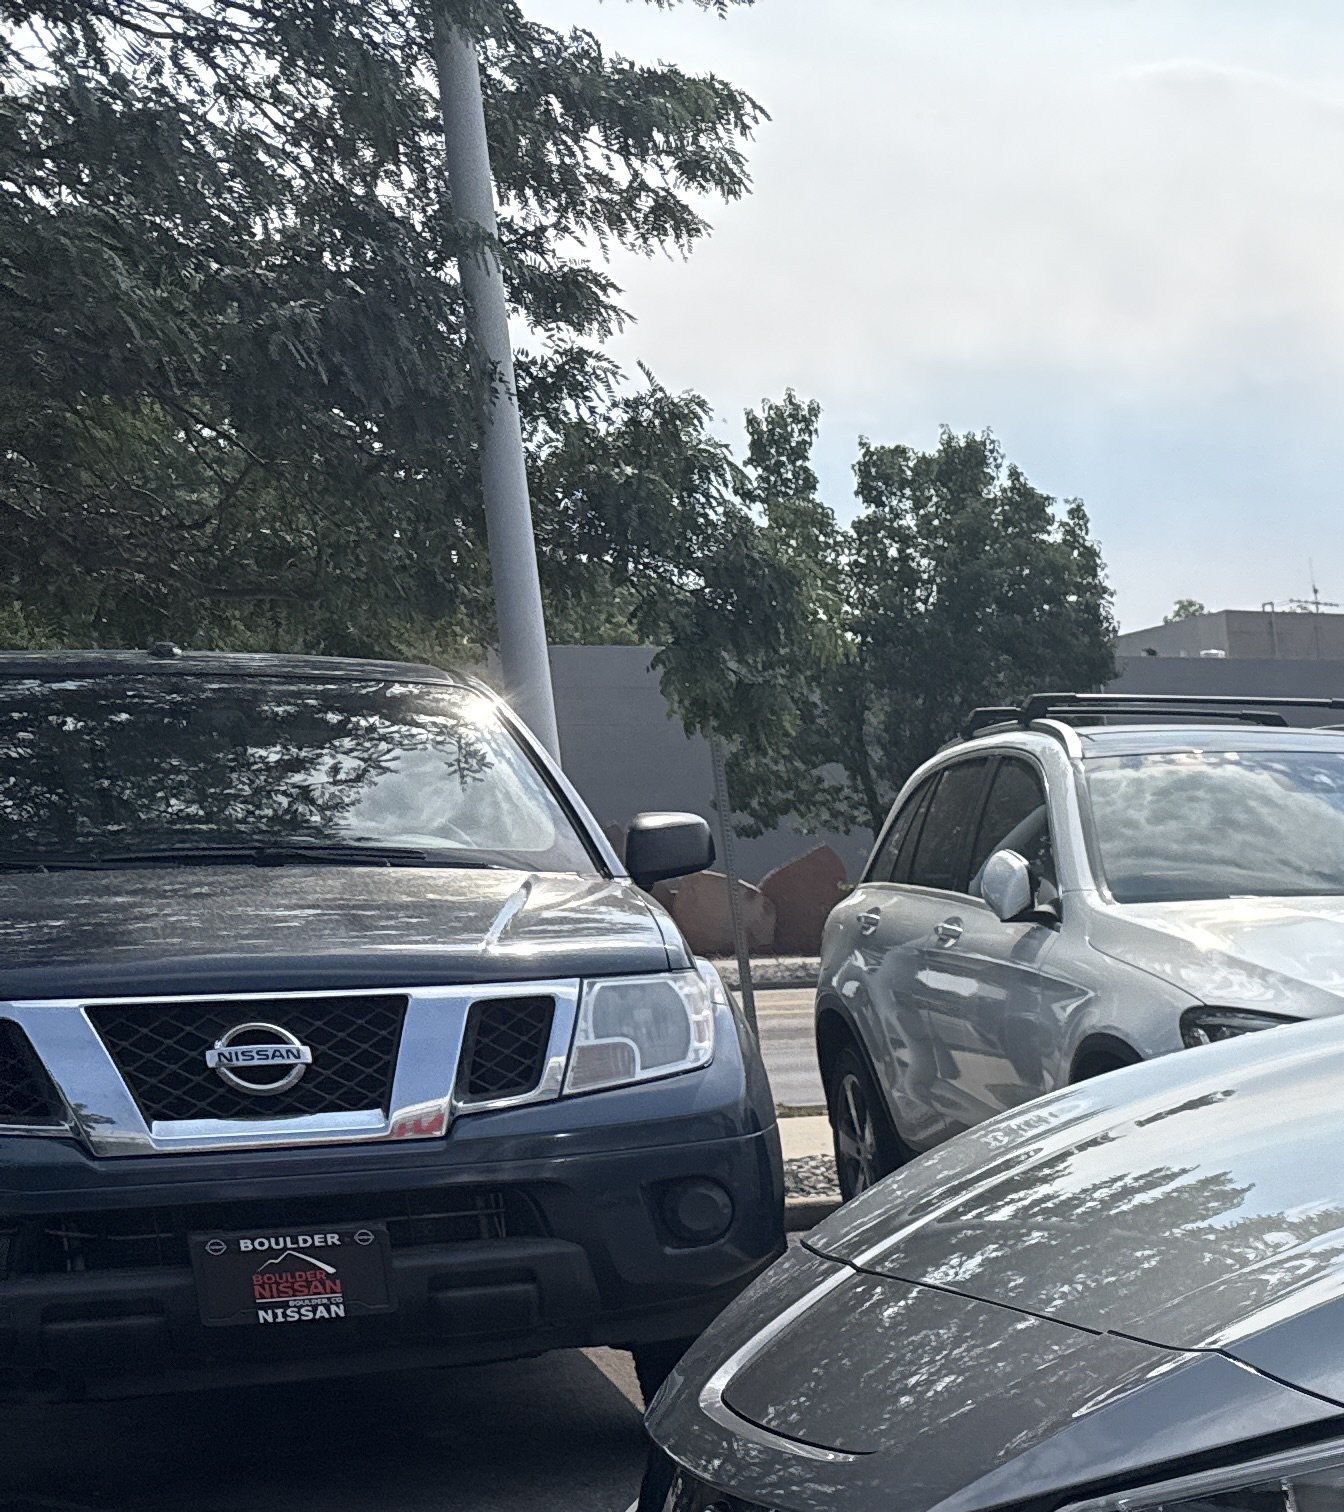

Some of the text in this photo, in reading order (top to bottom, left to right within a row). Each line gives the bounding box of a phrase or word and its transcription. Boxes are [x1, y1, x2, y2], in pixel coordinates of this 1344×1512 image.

[217, 1048, 301, 1062] NISSAN
[239, 1233, 341, 1251] BOULDER
[252, 1269, 327, 1285] BOULDER
[253, 1279, 343, 1298] NISSAN
[257, 1304, 346, 1323] NISSAN
